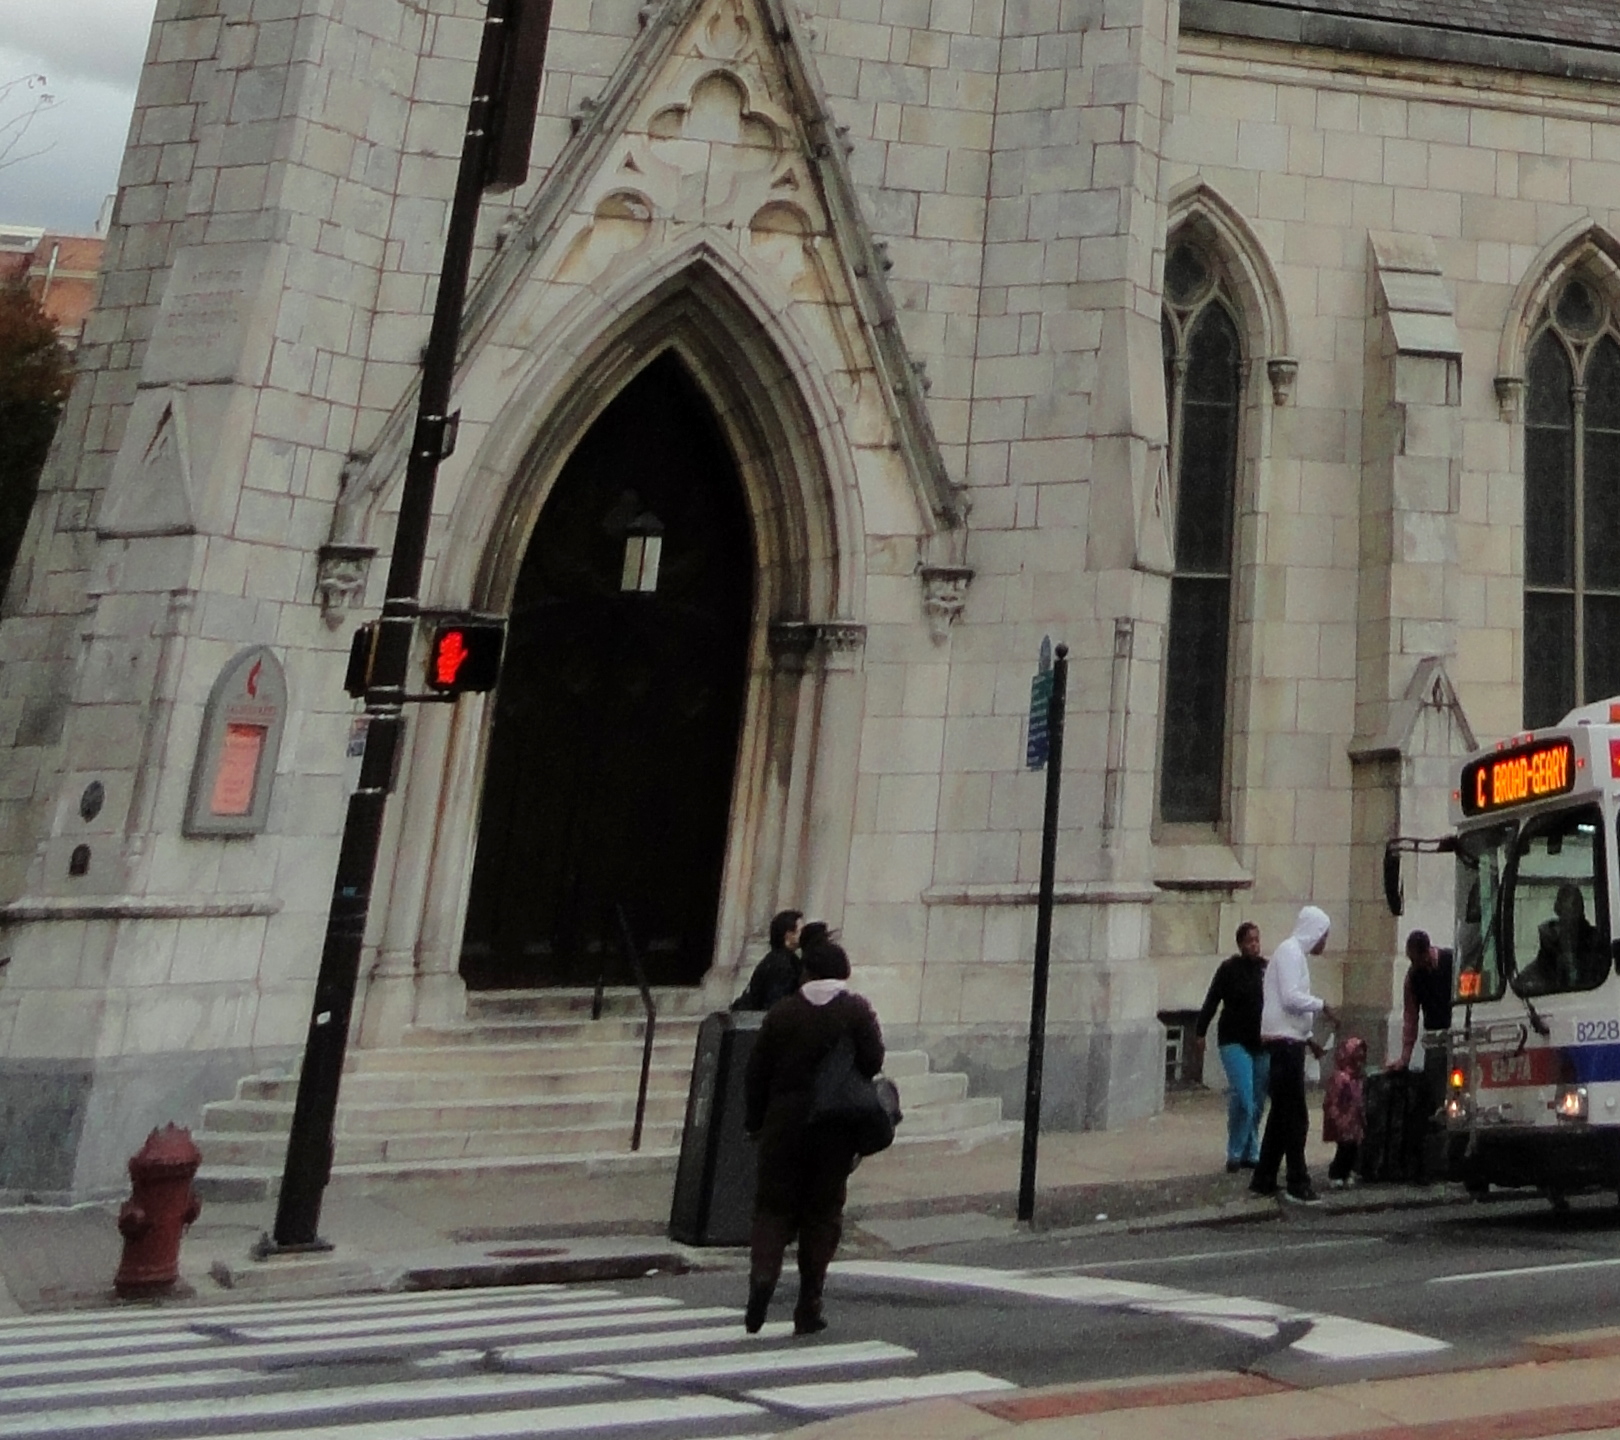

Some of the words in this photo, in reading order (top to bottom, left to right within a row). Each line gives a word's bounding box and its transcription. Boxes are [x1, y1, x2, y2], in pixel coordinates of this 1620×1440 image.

[1477, 767, 1487, 809] C
[1493, 744, 1569, 804] BROAD-GEARY
[1576, 1020, 1620, 1042] 8228
